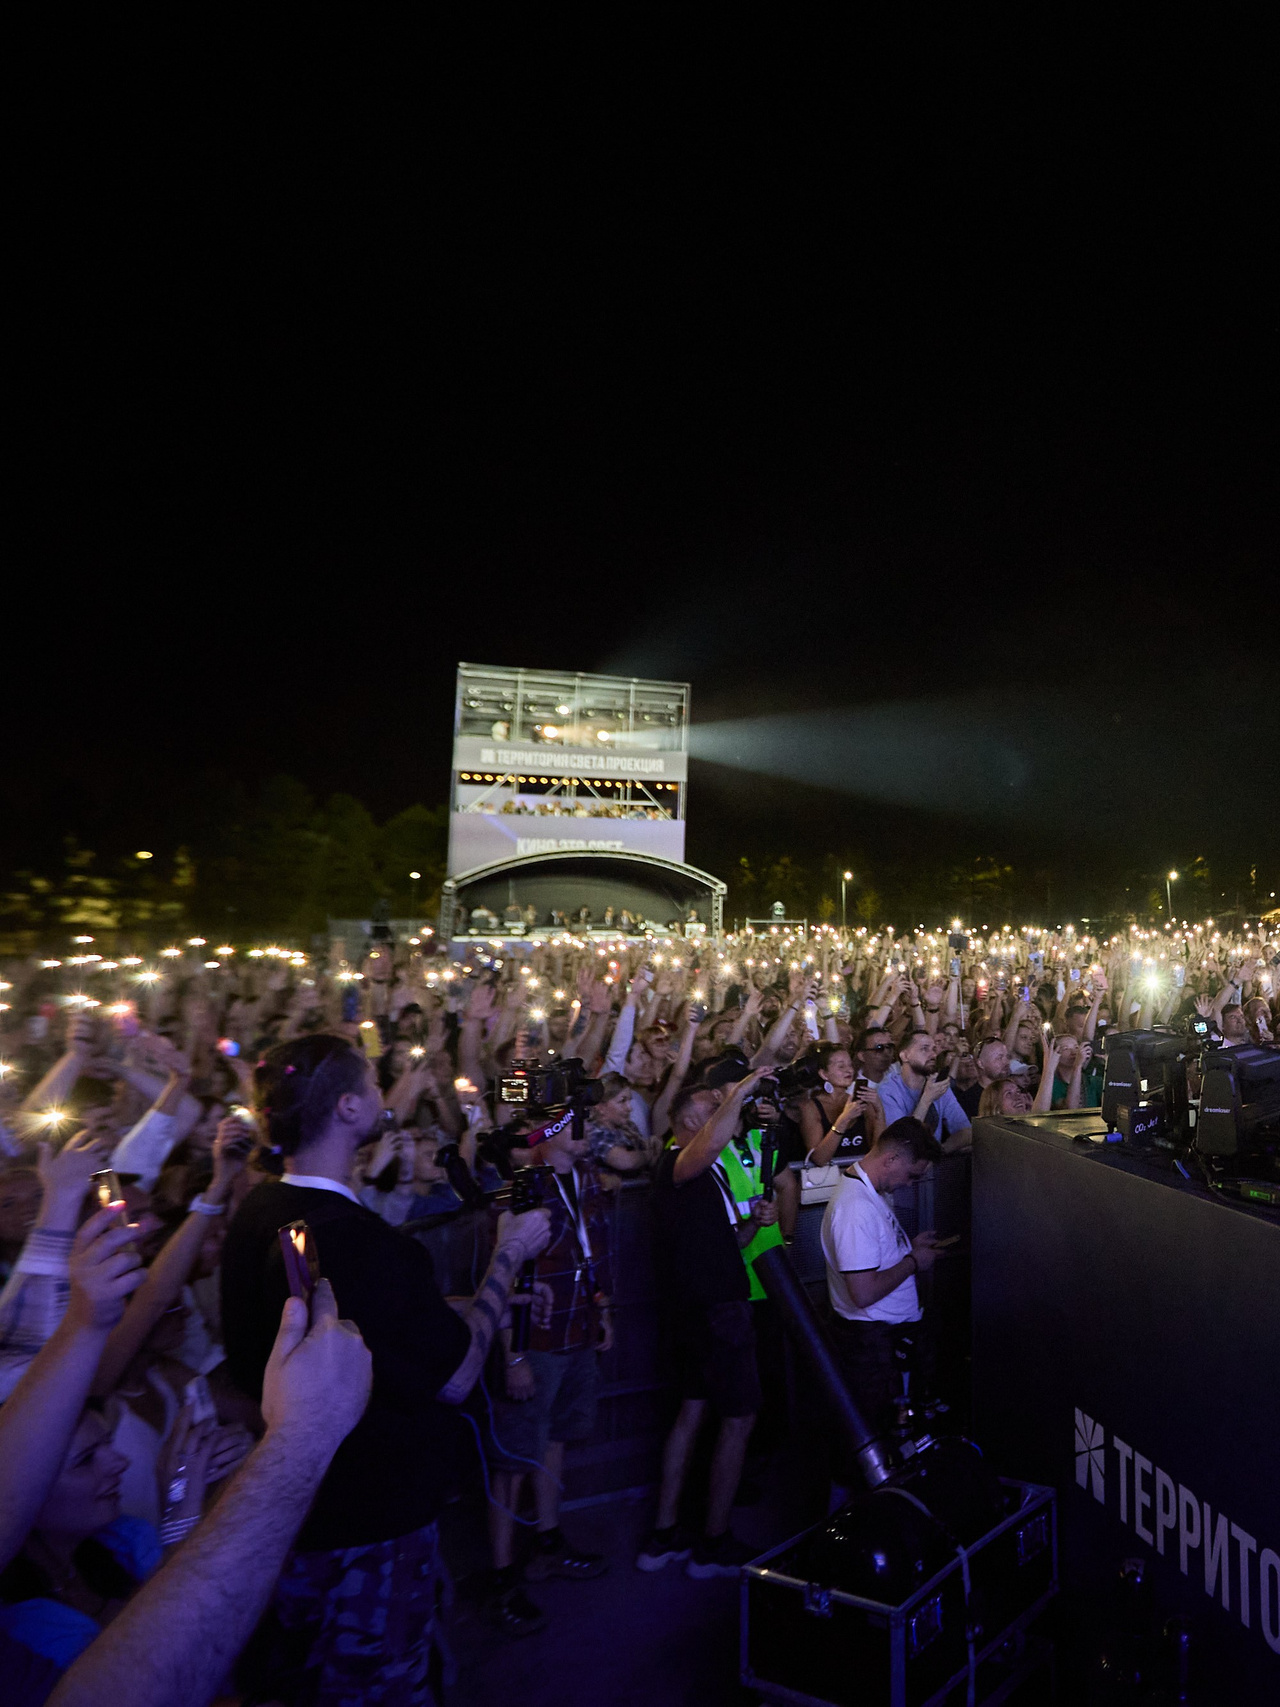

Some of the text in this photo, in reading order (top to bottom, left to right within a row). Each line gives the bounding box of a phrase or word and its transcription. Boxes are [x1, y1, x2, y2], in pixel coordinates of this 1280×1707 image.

[497, 749, 665, 774] ТЕРРИТОРИЯ СВЕТА ПРОЕКЦИЯ
[544, 1109, 575, 1138] RONIN
[841, 1135, 863, 1147] &G
